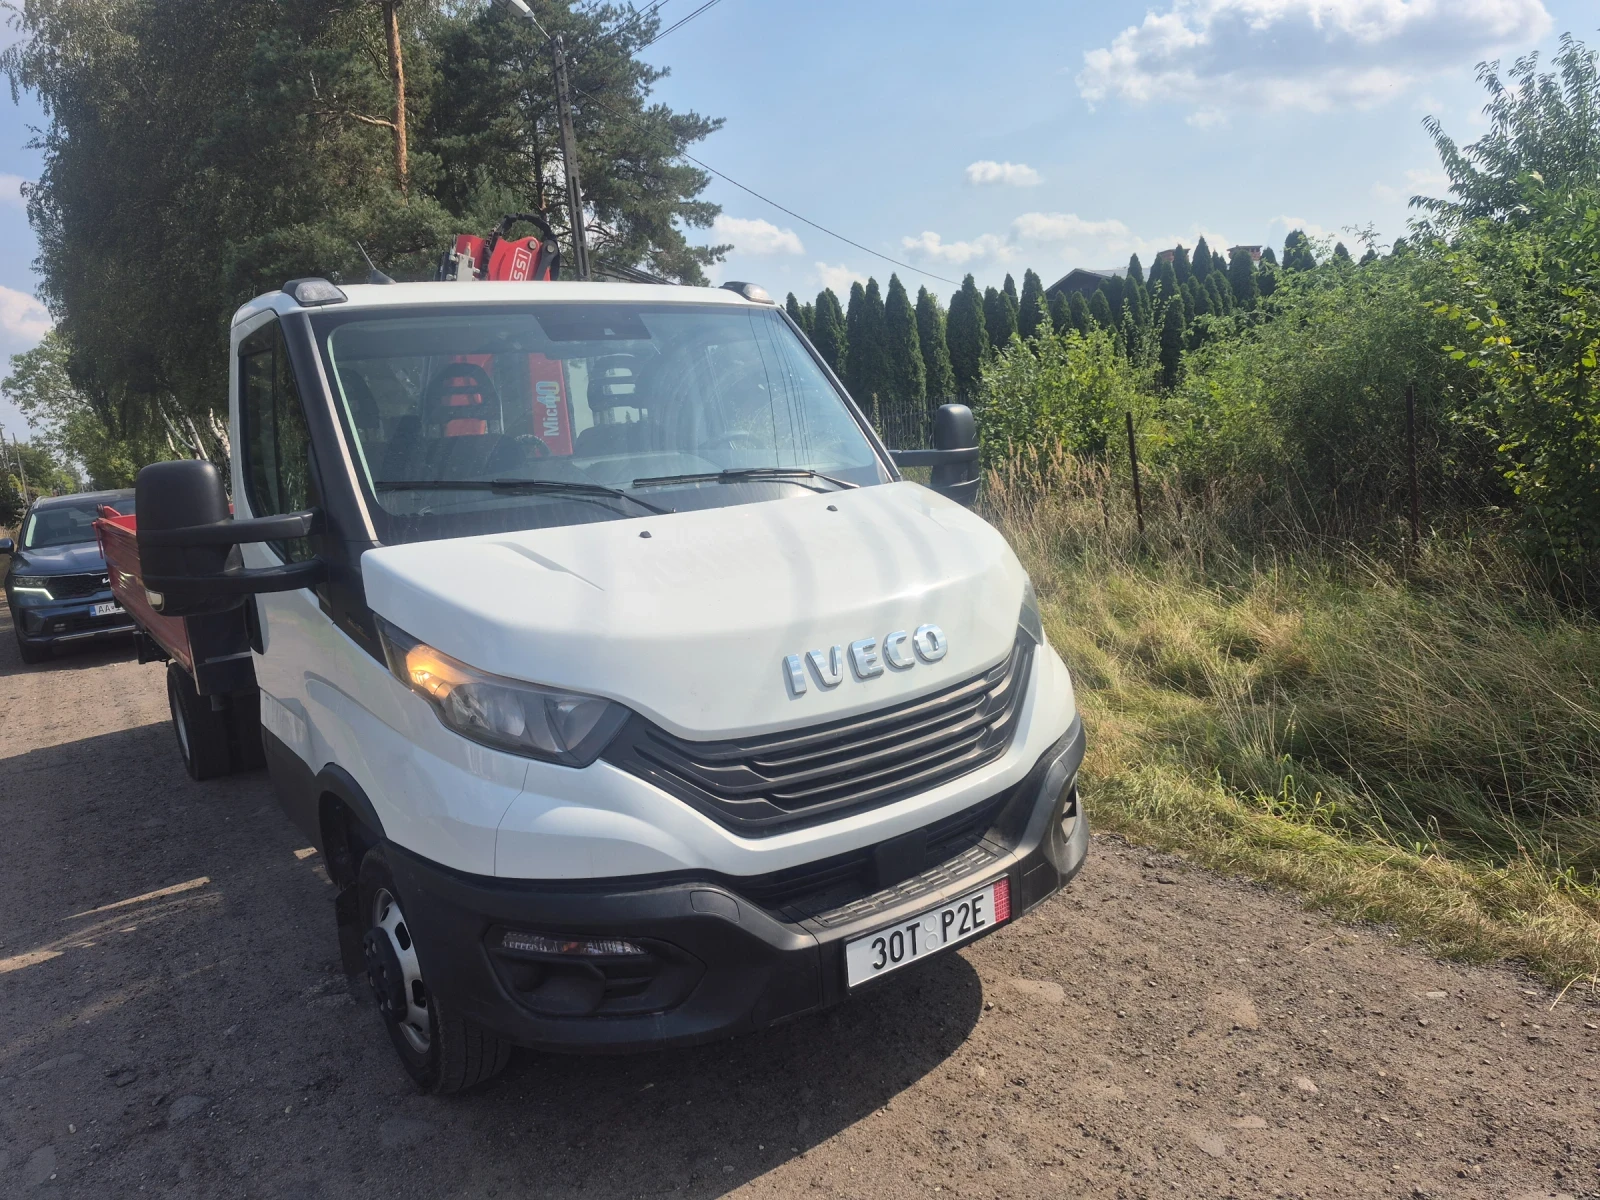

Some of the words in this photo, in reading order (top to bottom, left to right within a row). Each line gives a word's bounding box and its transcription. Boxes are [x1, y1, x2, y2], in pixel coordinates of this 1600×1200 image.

[782, 623, 948, 696] IVECO
[871, 921, 921, 970] 30T
[941, 894, 986, 943] P2E
